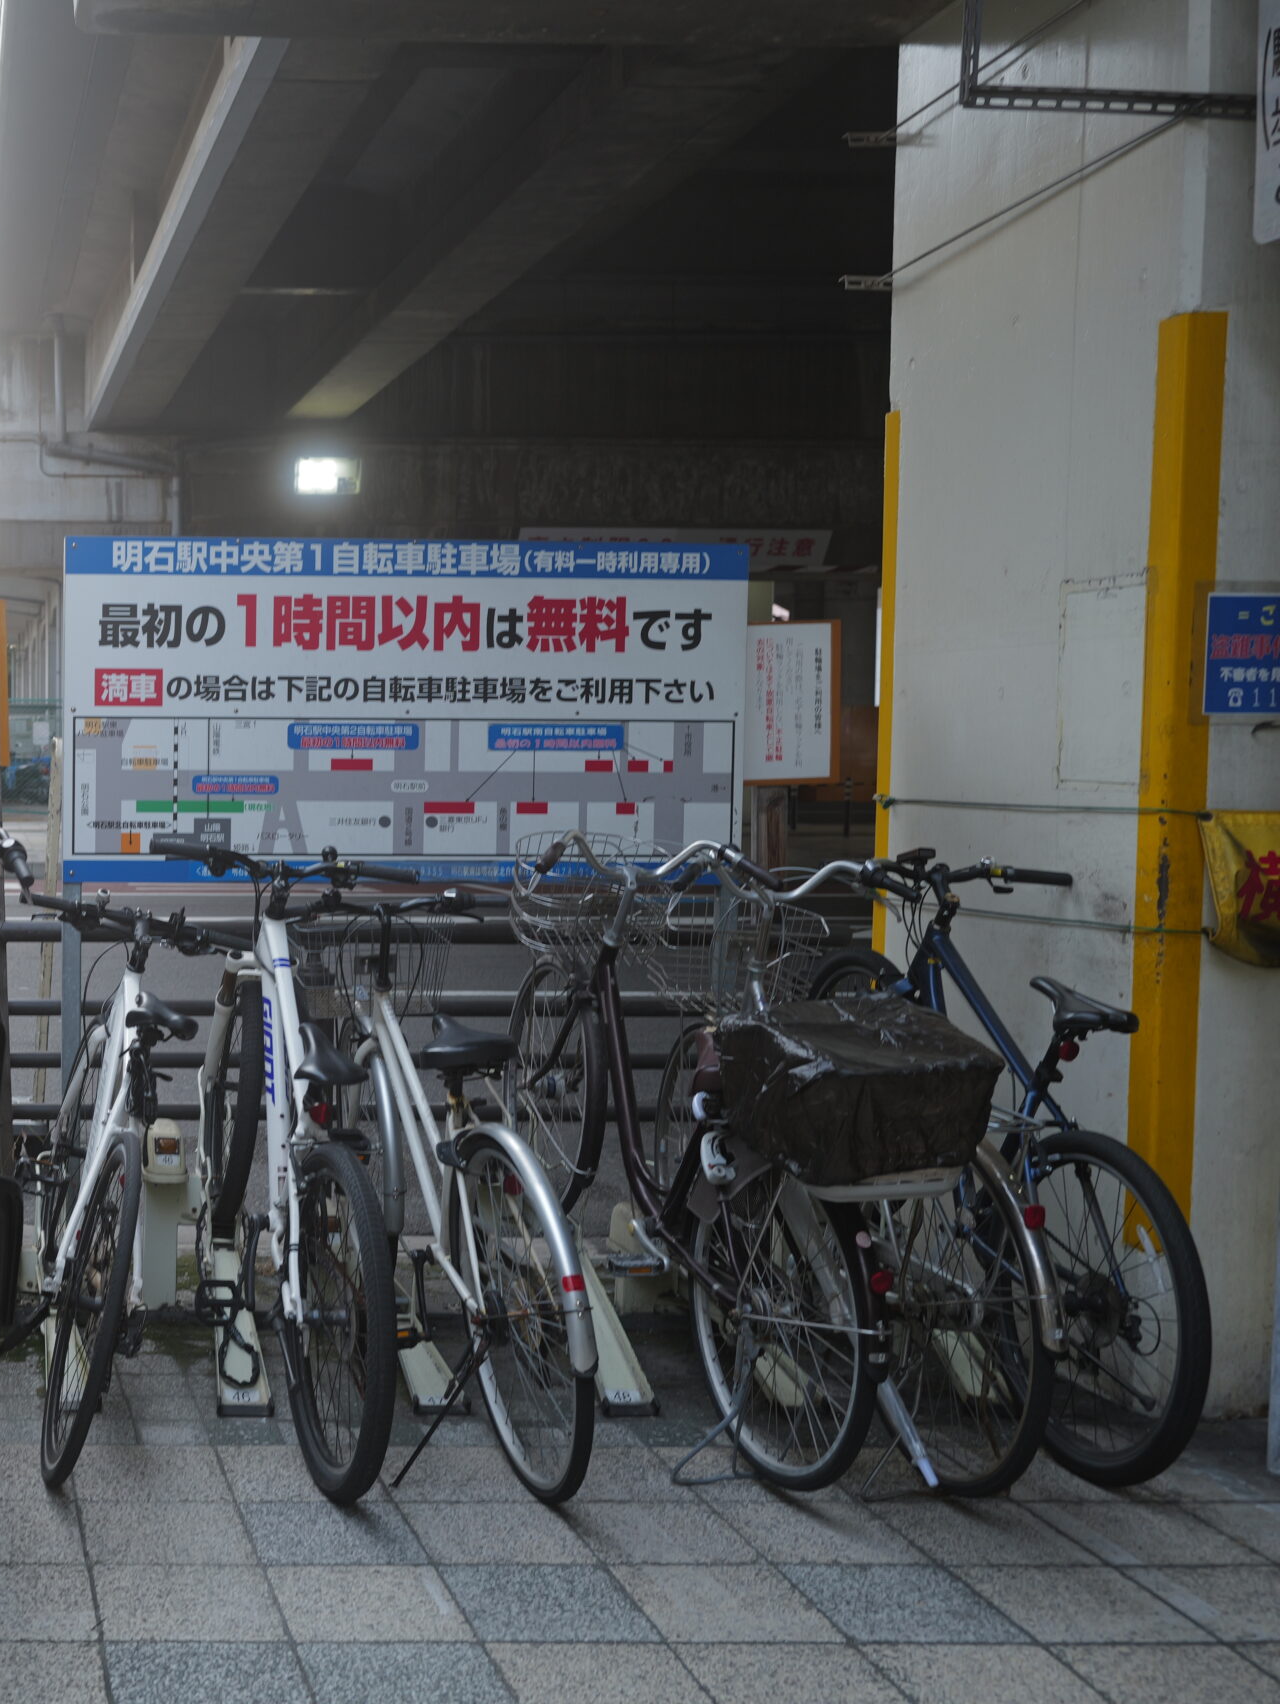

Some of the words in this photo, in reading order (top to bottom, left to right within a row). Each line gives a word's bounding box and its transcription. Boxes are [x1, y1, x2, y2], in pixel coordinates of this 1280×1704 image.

[99, 594, 712, 653] 最初の1時間以内は無料です
[262, 996, 275, 1107] GIANT
